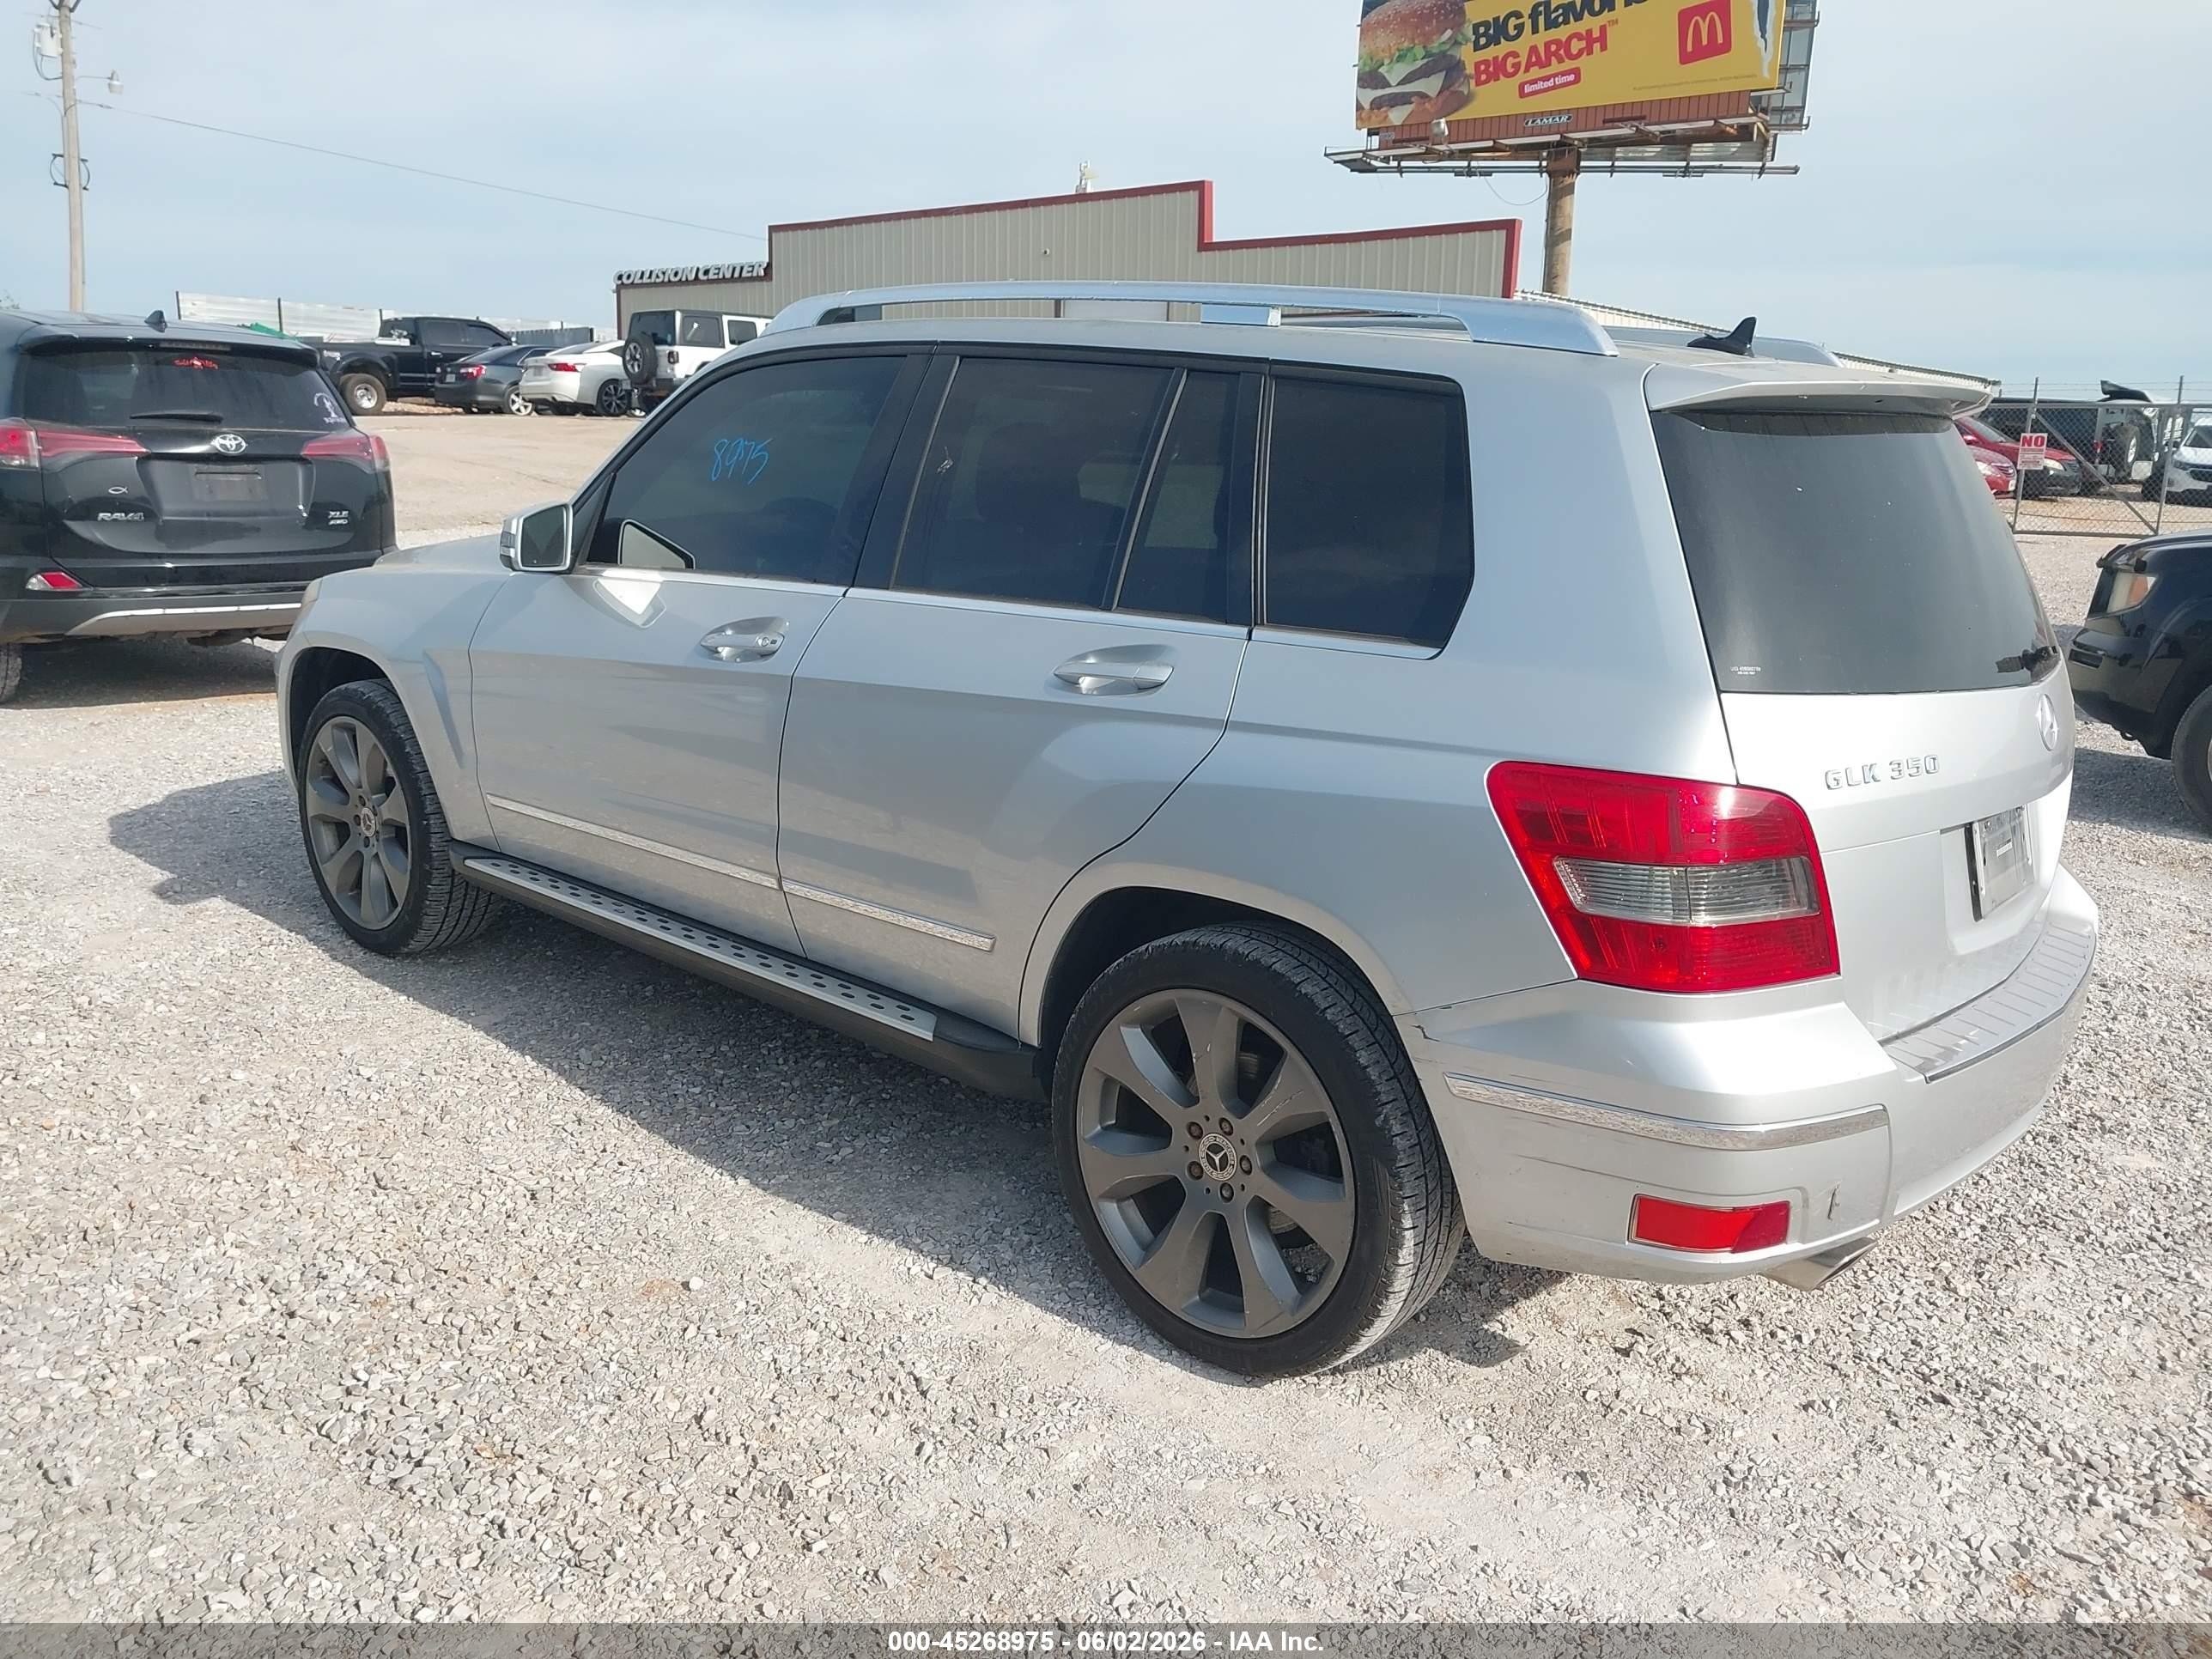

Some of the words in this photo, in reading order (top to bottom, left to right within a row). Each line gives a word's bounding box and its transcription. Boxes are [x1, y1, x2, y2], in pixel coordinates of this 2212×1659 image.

[1473, 10, 1525, 52] BIG
[1474, 50, 1522, 88] BIG
[1524, 77, 1554, 94] limited
[1554, 74, 1576, 85] time
[1528, 115, 1570, 125] LAMAR
[613, 265, 696, 285] COLLISION
[697, 261, 768, 280] CENTER
[2021, 434, 2045, 447] NO
[712, 438, 774, 485] 8975
[97, 512, 144, 521] RAV4
[1825, 763, 1881, 790] GLK
[1889, 755, 1940, 780] 350
